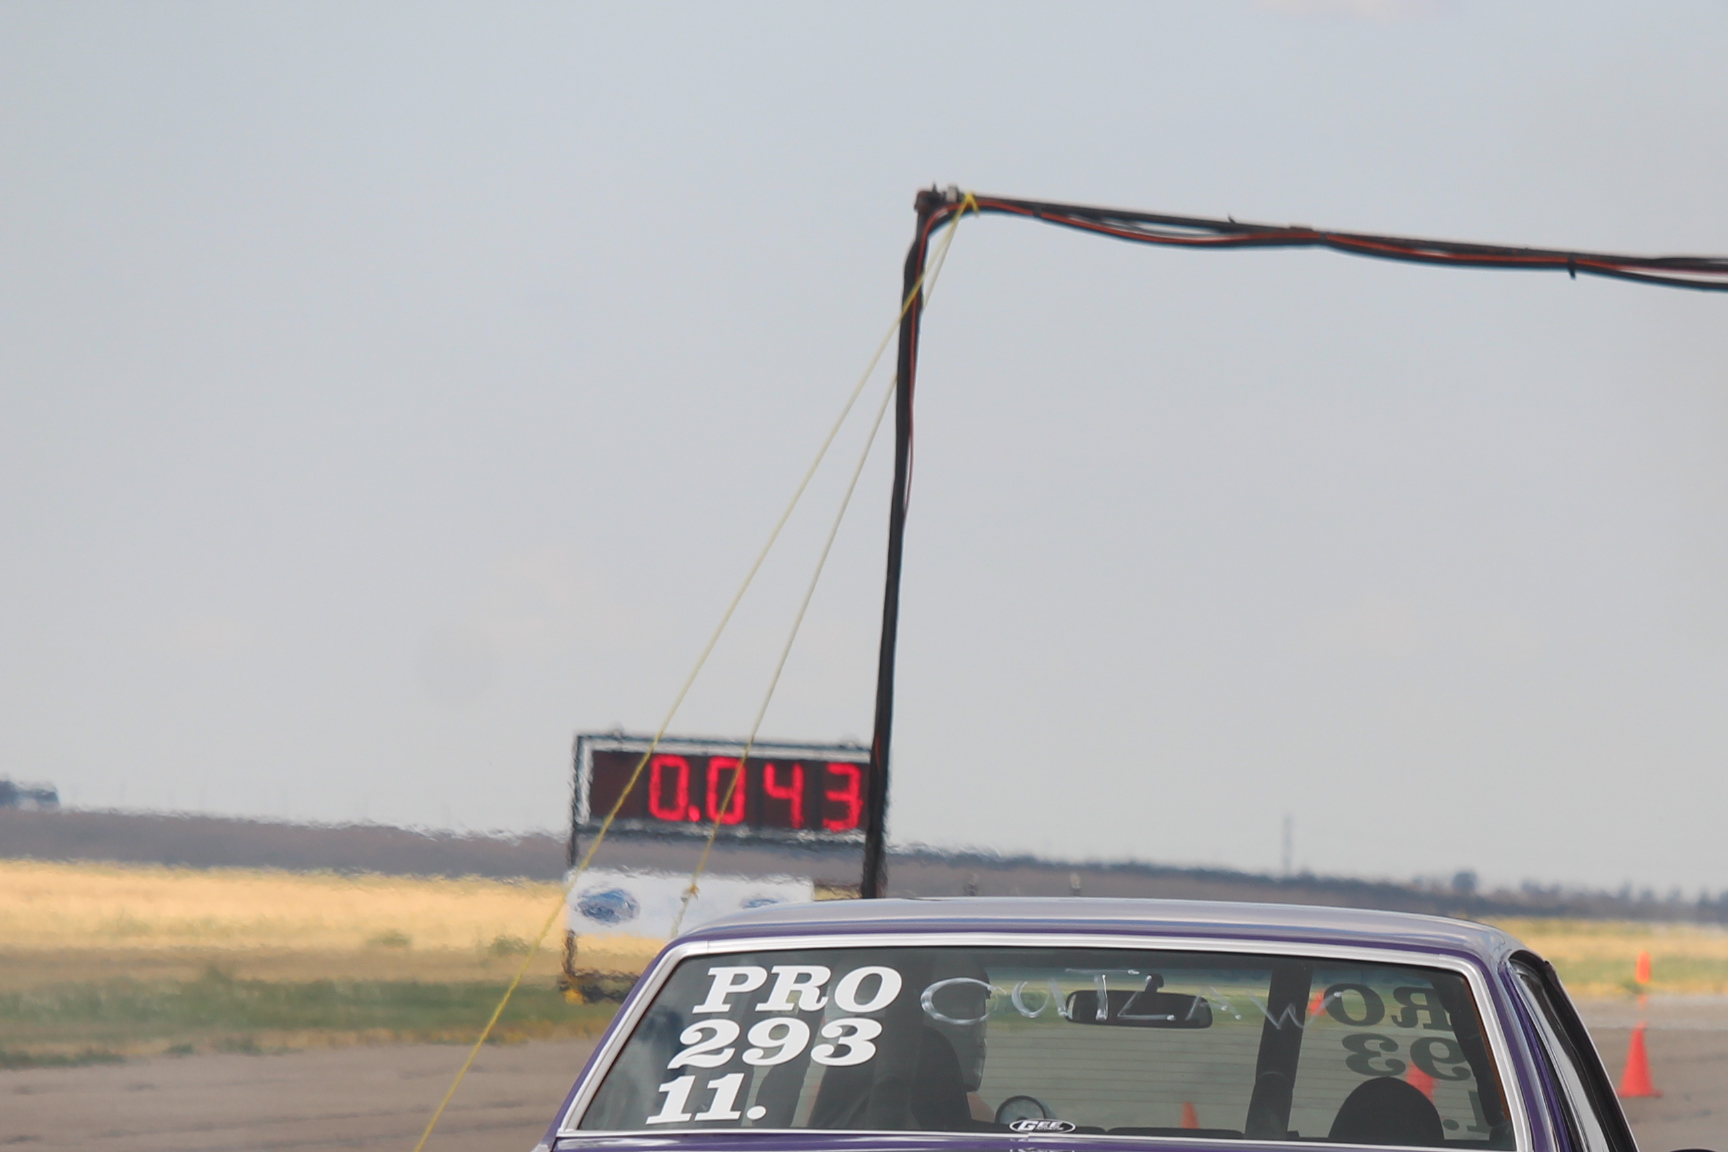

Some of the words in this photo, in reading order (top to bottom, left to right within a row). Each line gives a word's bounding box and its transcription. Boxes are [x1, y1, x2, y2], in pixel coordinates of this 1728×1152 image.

[648, 753, 864, 832] 0.043
[691, 965, 903, 1014] PRO
[667, 1017, 883, 1070] 293
[646, 1073, 767, 1125] 11.
